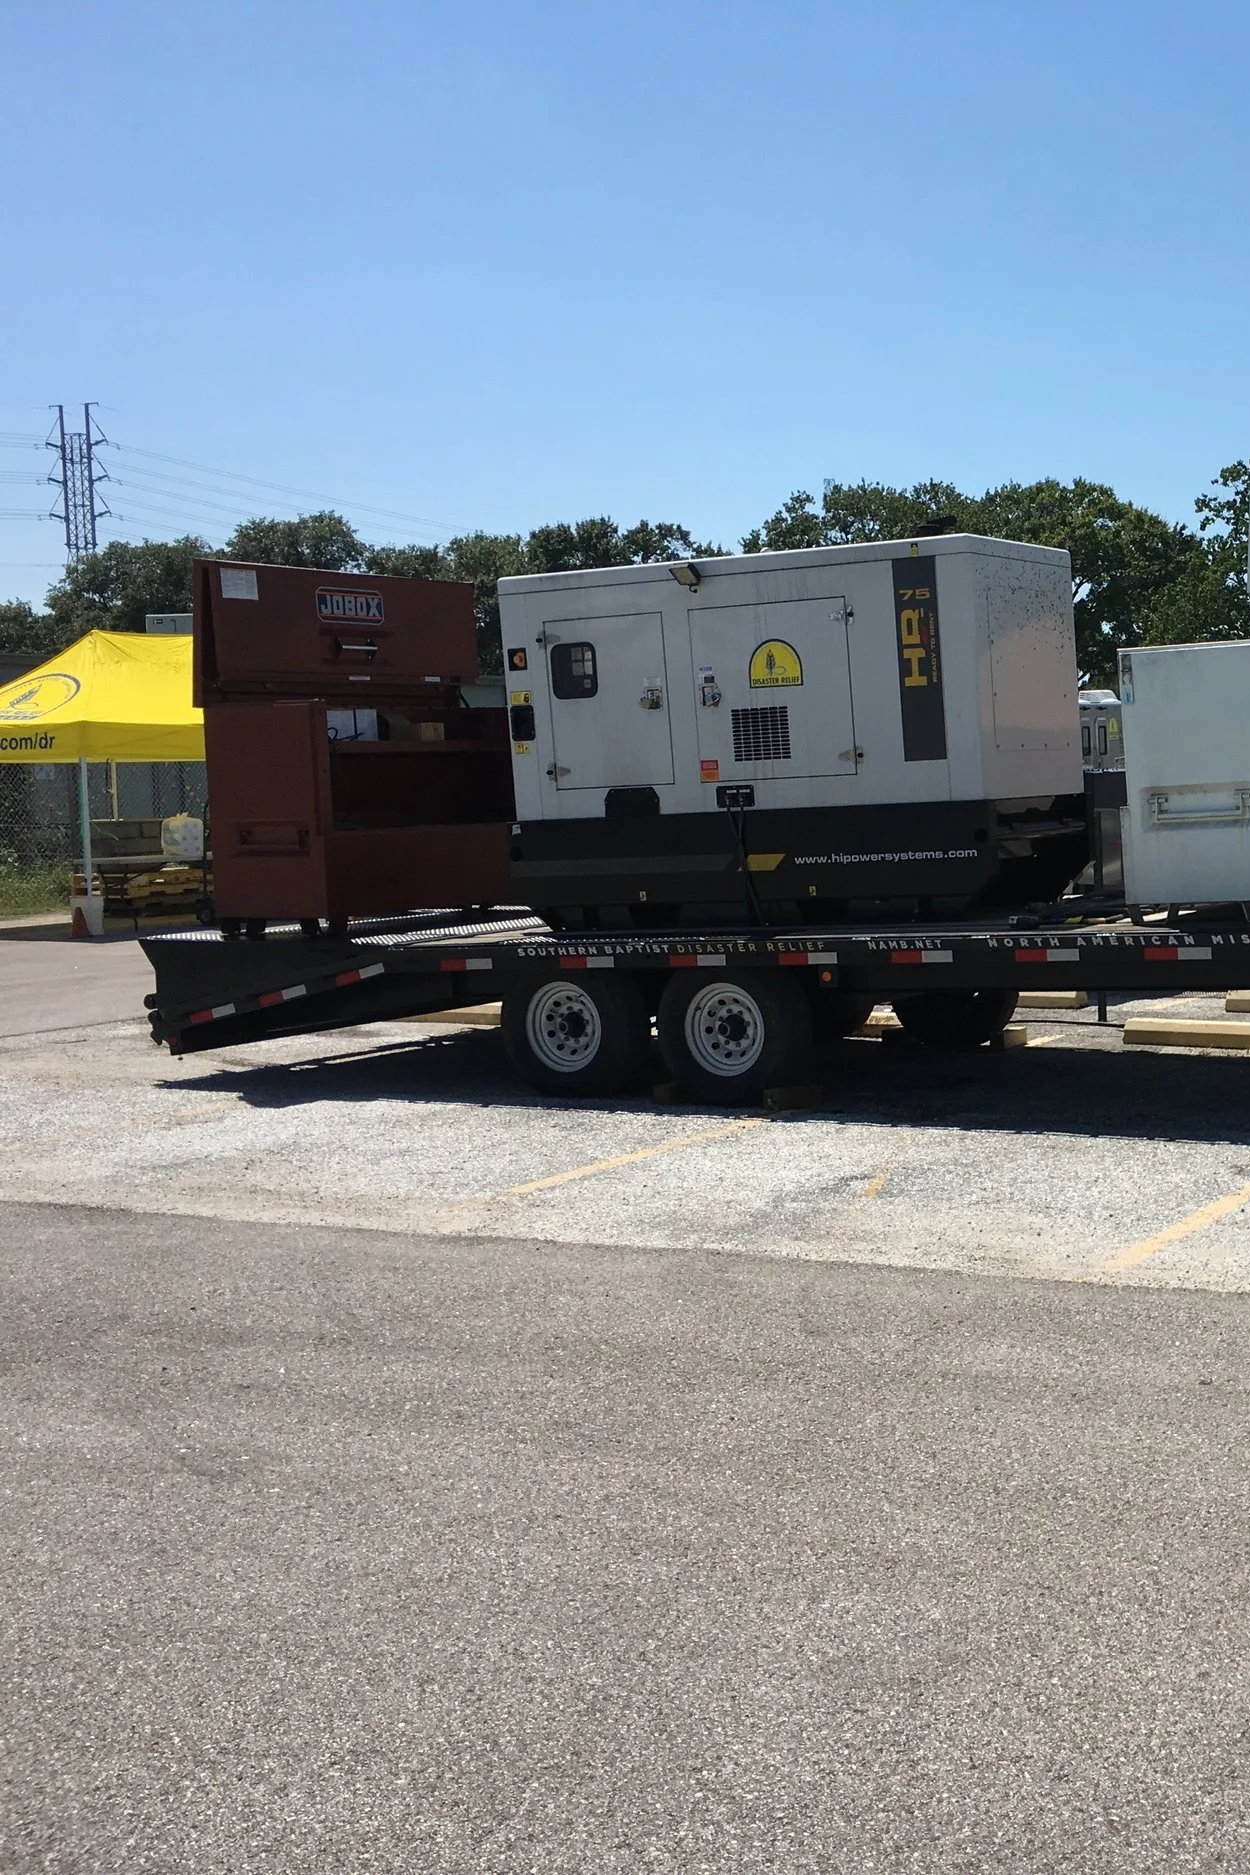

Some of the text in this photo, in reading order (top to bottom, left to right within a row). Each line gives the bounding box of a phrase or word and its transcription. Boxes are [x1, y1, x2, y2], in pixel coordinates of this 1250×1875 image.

[898, 588, 931, 601] 75
[320, 594, 381, 617] JOBOX
[930, 638, 936, 649] TO
[930, 652, 938, 683] READY
[752, 675, 800, 686] DISASTER RELIEF
[794, 849, 978, 865] www.hipowersystems.com
[517, 945, 598, 957] SOUTHERN
[604, 944, 669, 955] BAPTIST
[677, 942, 757, 953] DISASTER
[766, 940, 826, 951] RELIEF
[867, 939, 943, 950] NAMB.NET
[987, 937, 1060, 948] NORTH
[1076, 935, 1195, 947] AMERICAN
